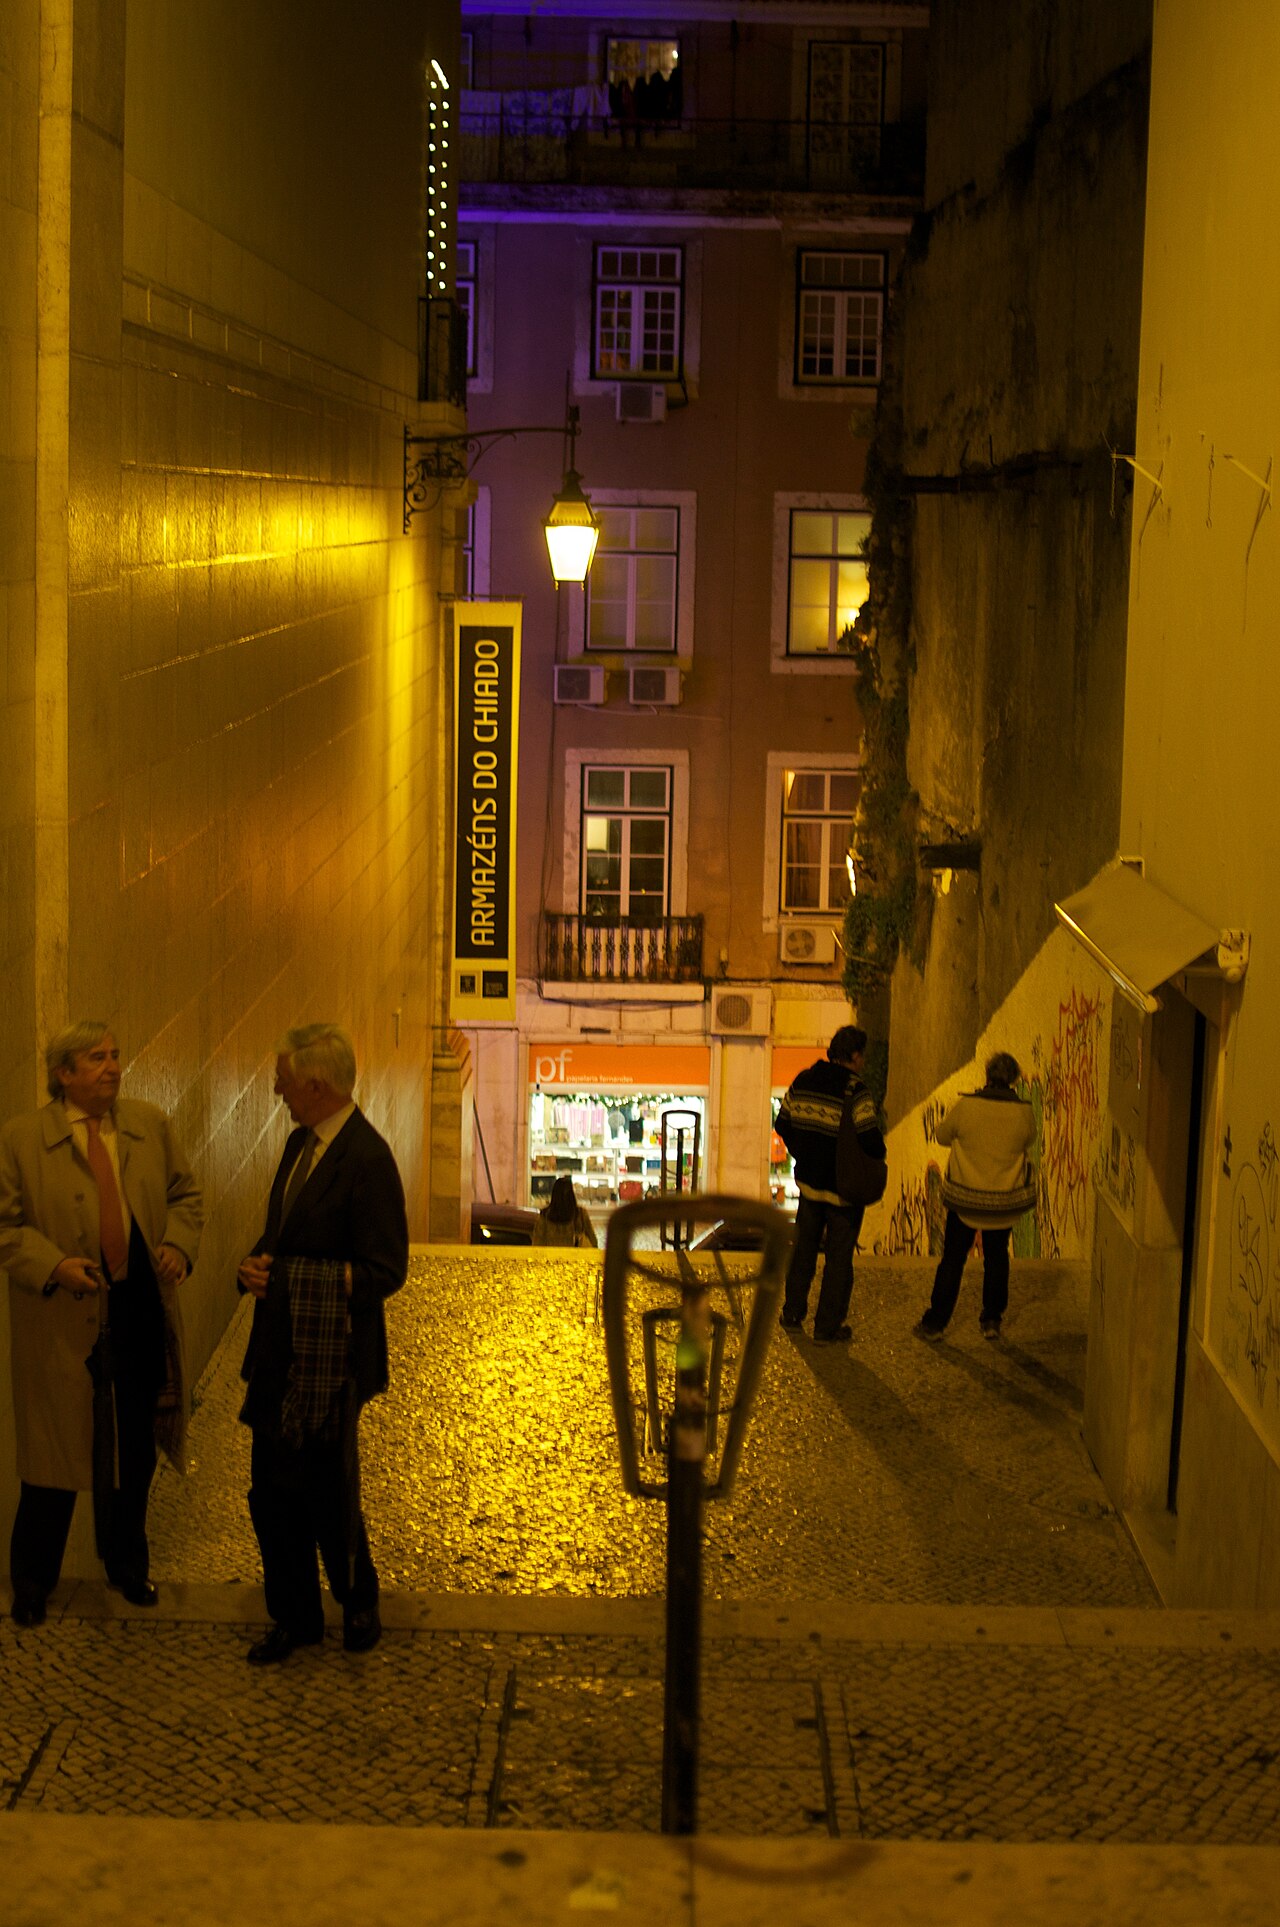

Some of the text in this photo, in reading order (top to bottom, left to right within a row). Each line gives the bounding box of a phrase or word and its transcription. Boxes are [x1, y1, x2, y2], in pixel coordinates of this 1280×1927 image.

[473, 638, 500, 743] CHIADO
[472, 750, 498, 789] DO
[466, 797, 497, 946] ARMAZÉNS
[535, 1048, 574, 1084] pf
